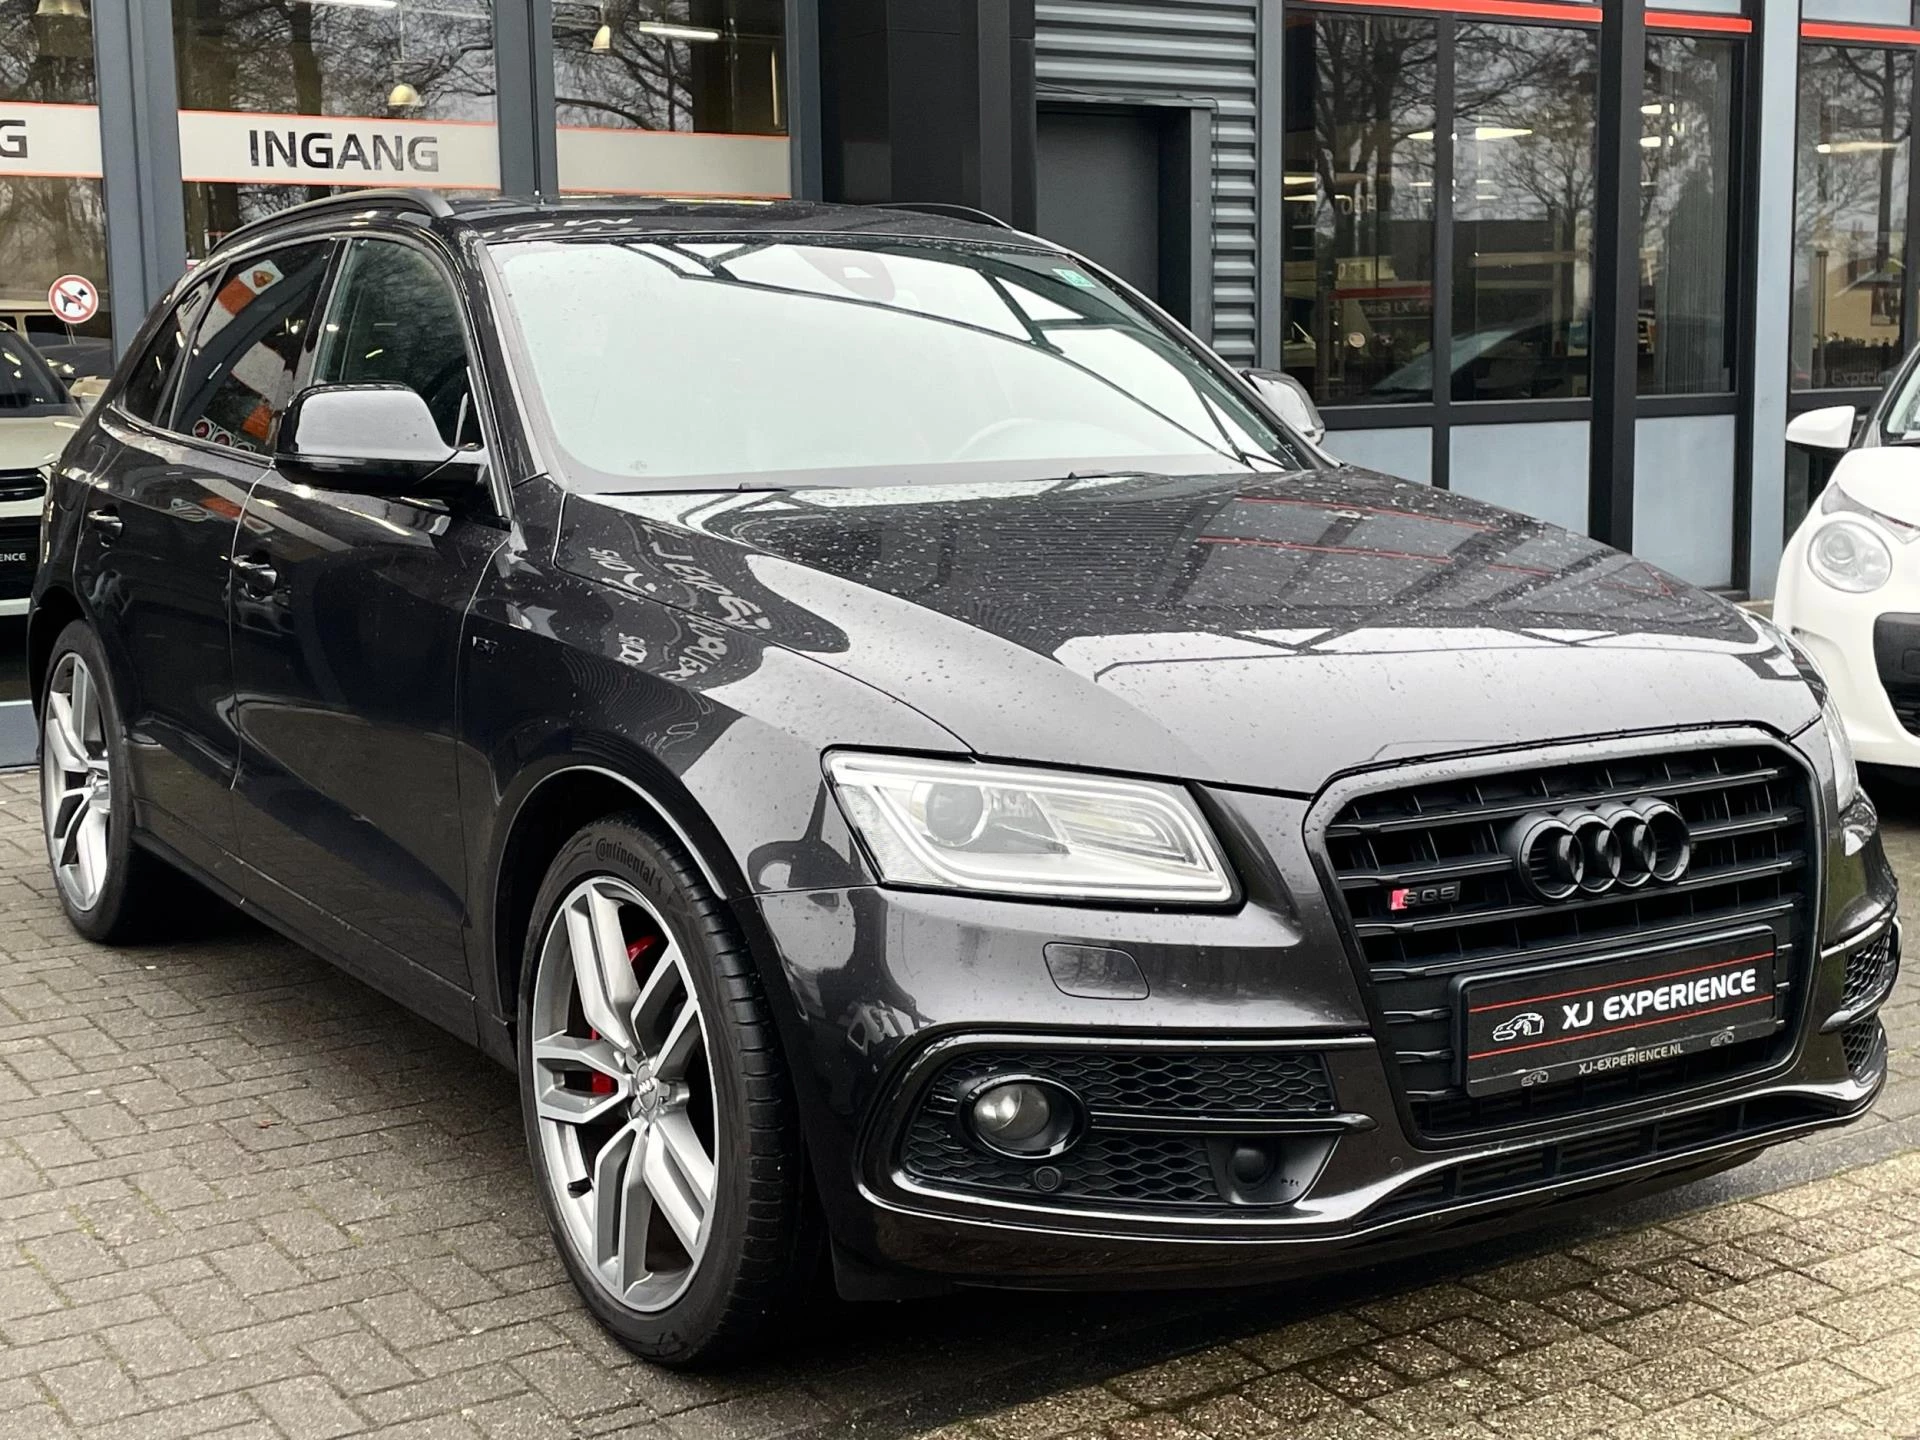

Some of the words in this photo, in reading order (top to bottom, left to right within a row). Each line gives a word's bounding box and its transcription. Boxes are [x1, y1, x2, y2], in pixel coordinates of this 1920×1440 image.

[0, 119, 28, 159] G
[249, 129, 440, 173] INGANG
[595, 838, 656, 886] Continental
[1562, 1001, 1594, 1030] XJ
[1603, 968, 1756, 1021] EXPERIENCE
[1578, 1043, 1684, 1074] XJ-EXPERIENCE.NL
